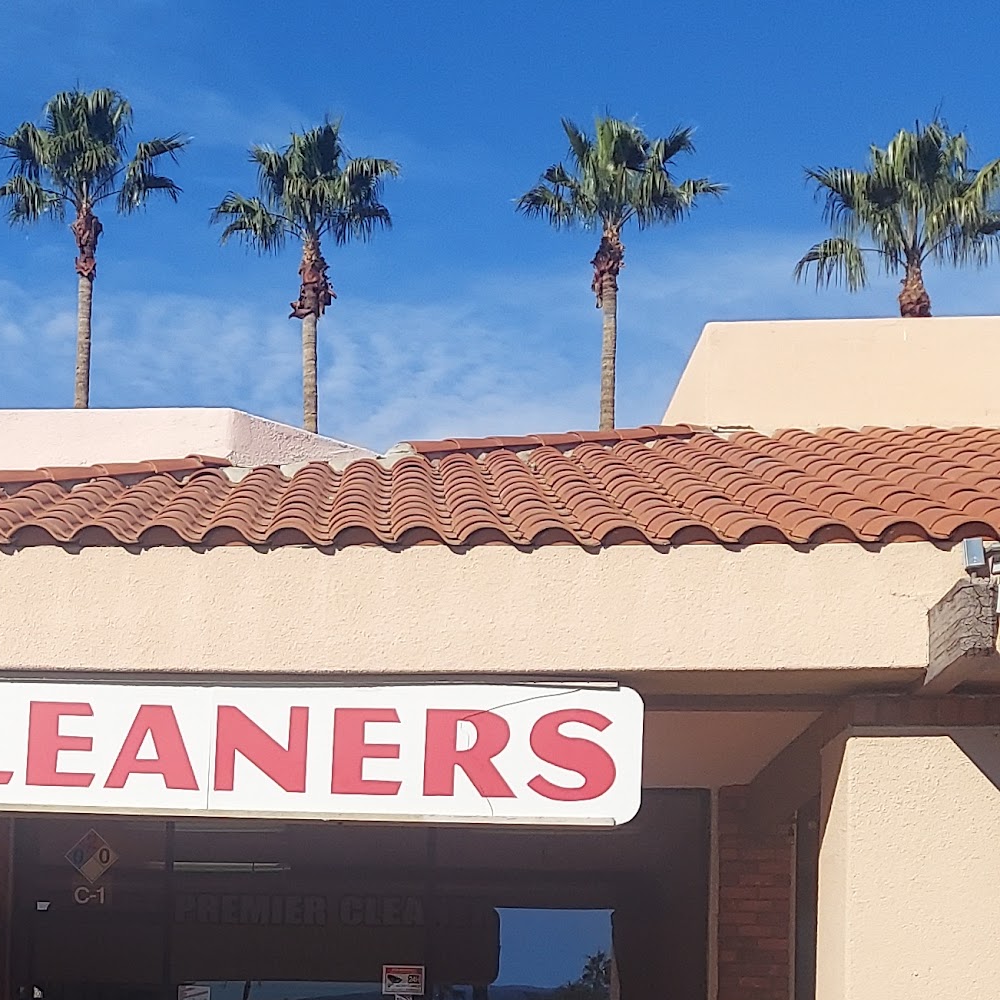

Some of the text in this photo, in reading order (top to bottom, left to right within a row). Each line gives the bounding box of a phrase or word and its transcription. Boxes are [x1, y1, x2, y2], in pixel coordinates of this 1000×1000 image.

[99, 847, 110, 864] 0
[74, 886, 105, 904] C-1
[174, 894, 328, 926] PREMIER
